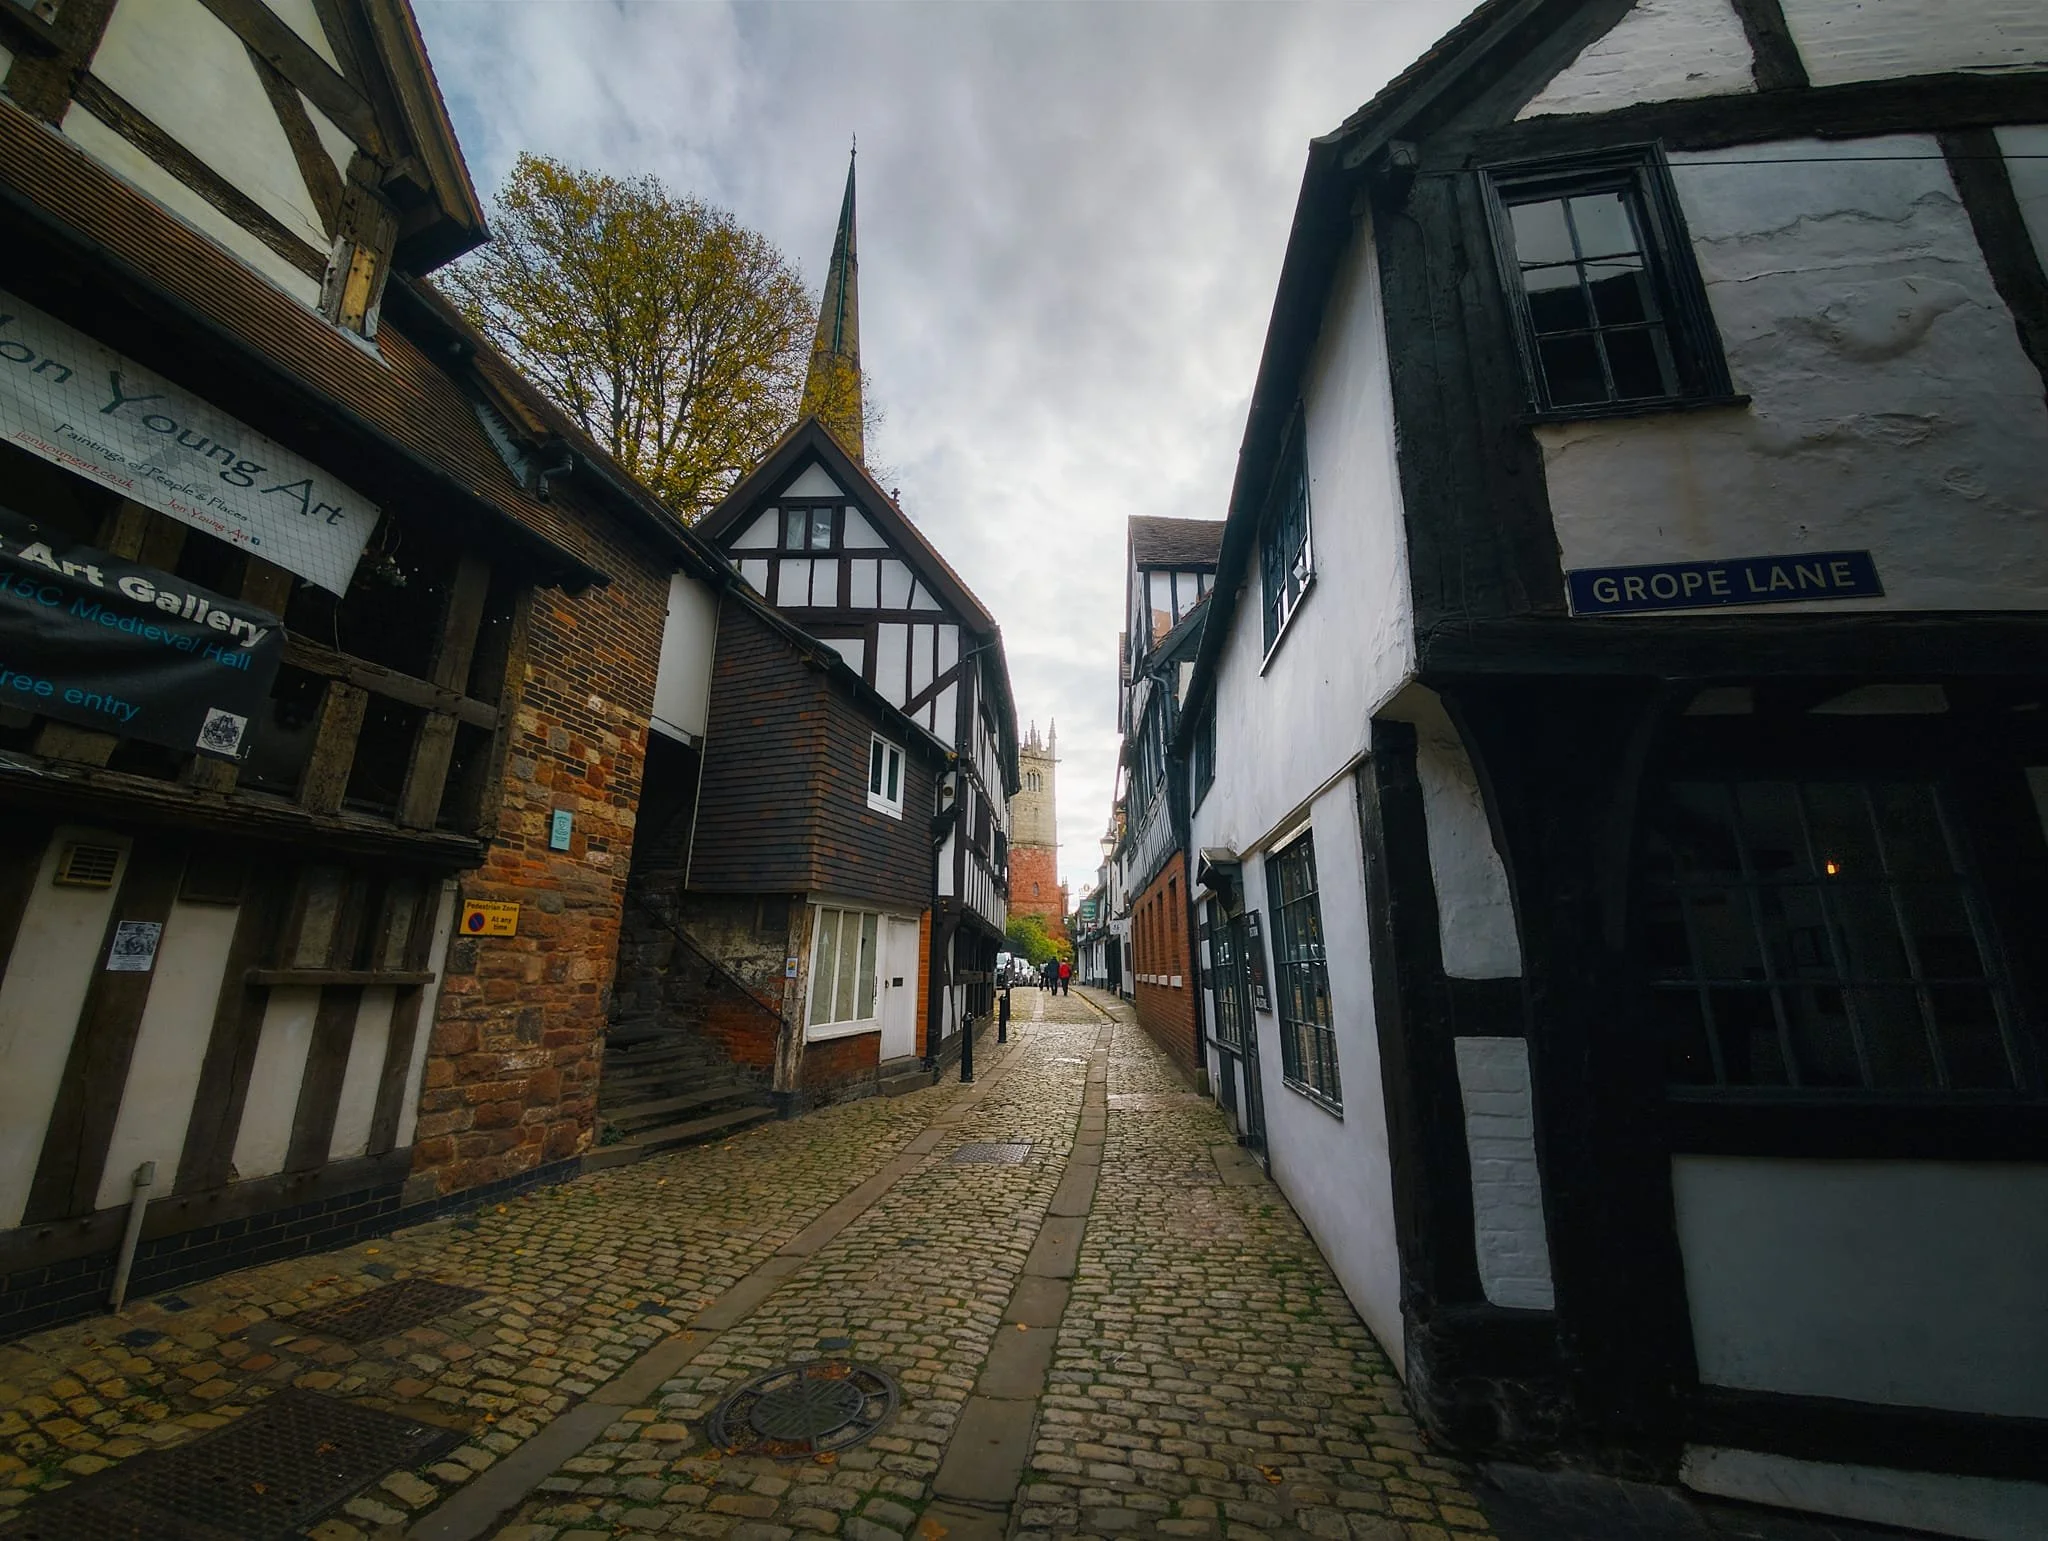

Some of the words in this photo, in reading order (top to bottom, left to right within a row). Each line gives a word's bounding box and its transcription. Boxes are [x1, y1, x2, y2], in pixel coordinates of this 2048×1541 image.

[0, 314, 73, 383] on
[100, 370, 267, 487] Young
[260, 478, 344, 525] Art
[54, 423, 126, 462] Paintings
[128, 463, 147, 475] of
[146, 467, 193, 494] People
[195, 493, 207, 501] &
[207, 497, 248, 521] Places
[164, 498, 186, 513] Jon
[191, 507, 225, 532] Young
[228, 528, 249, 541] Art
[17, 541, 104, 587] Art
[118, 576, 269, 648] Gallery
[1592, 570, 1732, 603] GROPE
[1746, 561, 1856, 593] LANE
[69, 596, 201, 654] Medieval
[202, 643, 252, 672] Hall
[0, 664, 54, 697] ree
[63, 687, 142, 723] entry
[467, 902, 501, 910] Pedestrian
[502, 904, 518, 912] Zone
